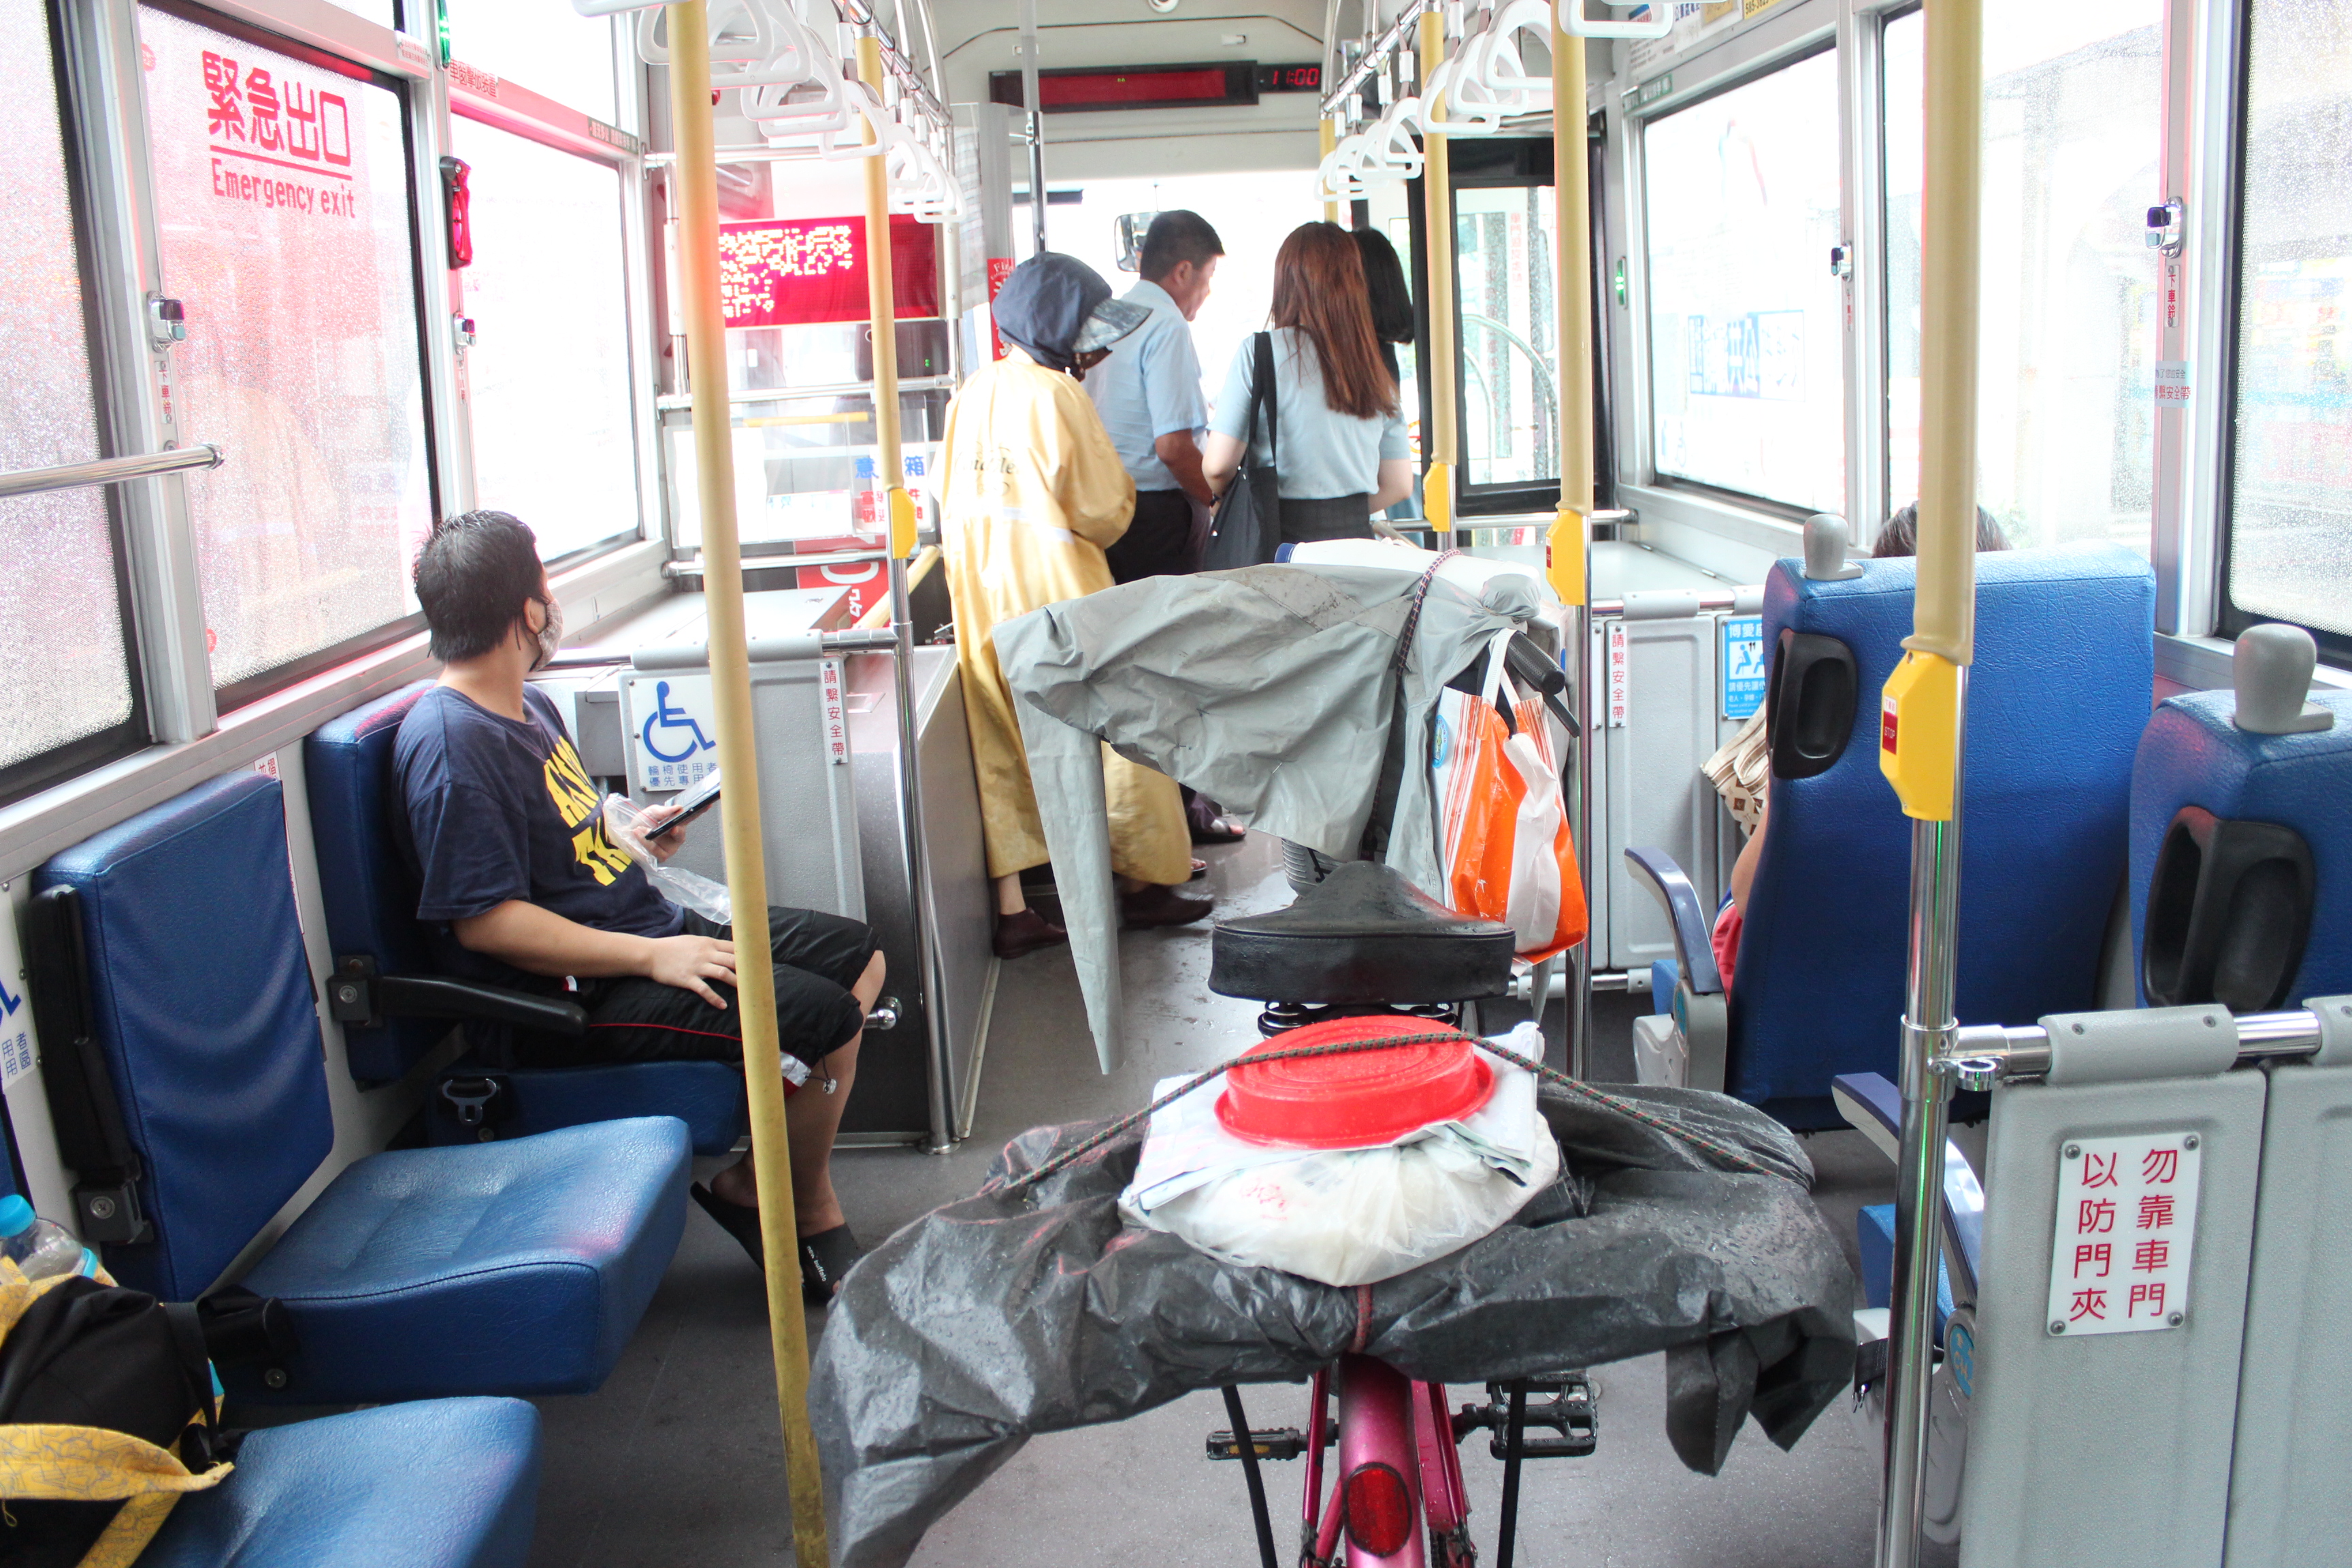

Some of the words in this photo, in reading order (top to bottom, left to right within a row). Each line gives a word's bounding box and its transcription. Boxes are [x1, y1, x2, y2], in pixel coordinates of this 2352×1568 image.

[1272, 67, 1320, 86] 11:00
[202, 50, 351, 167] 緊急出口
[211, 158, 315, 215] Emergency
[321, 182, 356, 218] exit
[2167, 274, 2176, 318] 下車鈴
[159, 370, 172, 414] 下車鈴
[854, 456, 925, 479] 意箱
[1612, 634, 1624, 719] 請繫安全帶
[823, 670, 845, 756] 請繫安全帶
[648, 762, 719, 776] 輪椅使用者
[2069, 1152, 2119, 1322] 以防門夾
[2127, 1148, 2178, 1319] 勿靠車門
